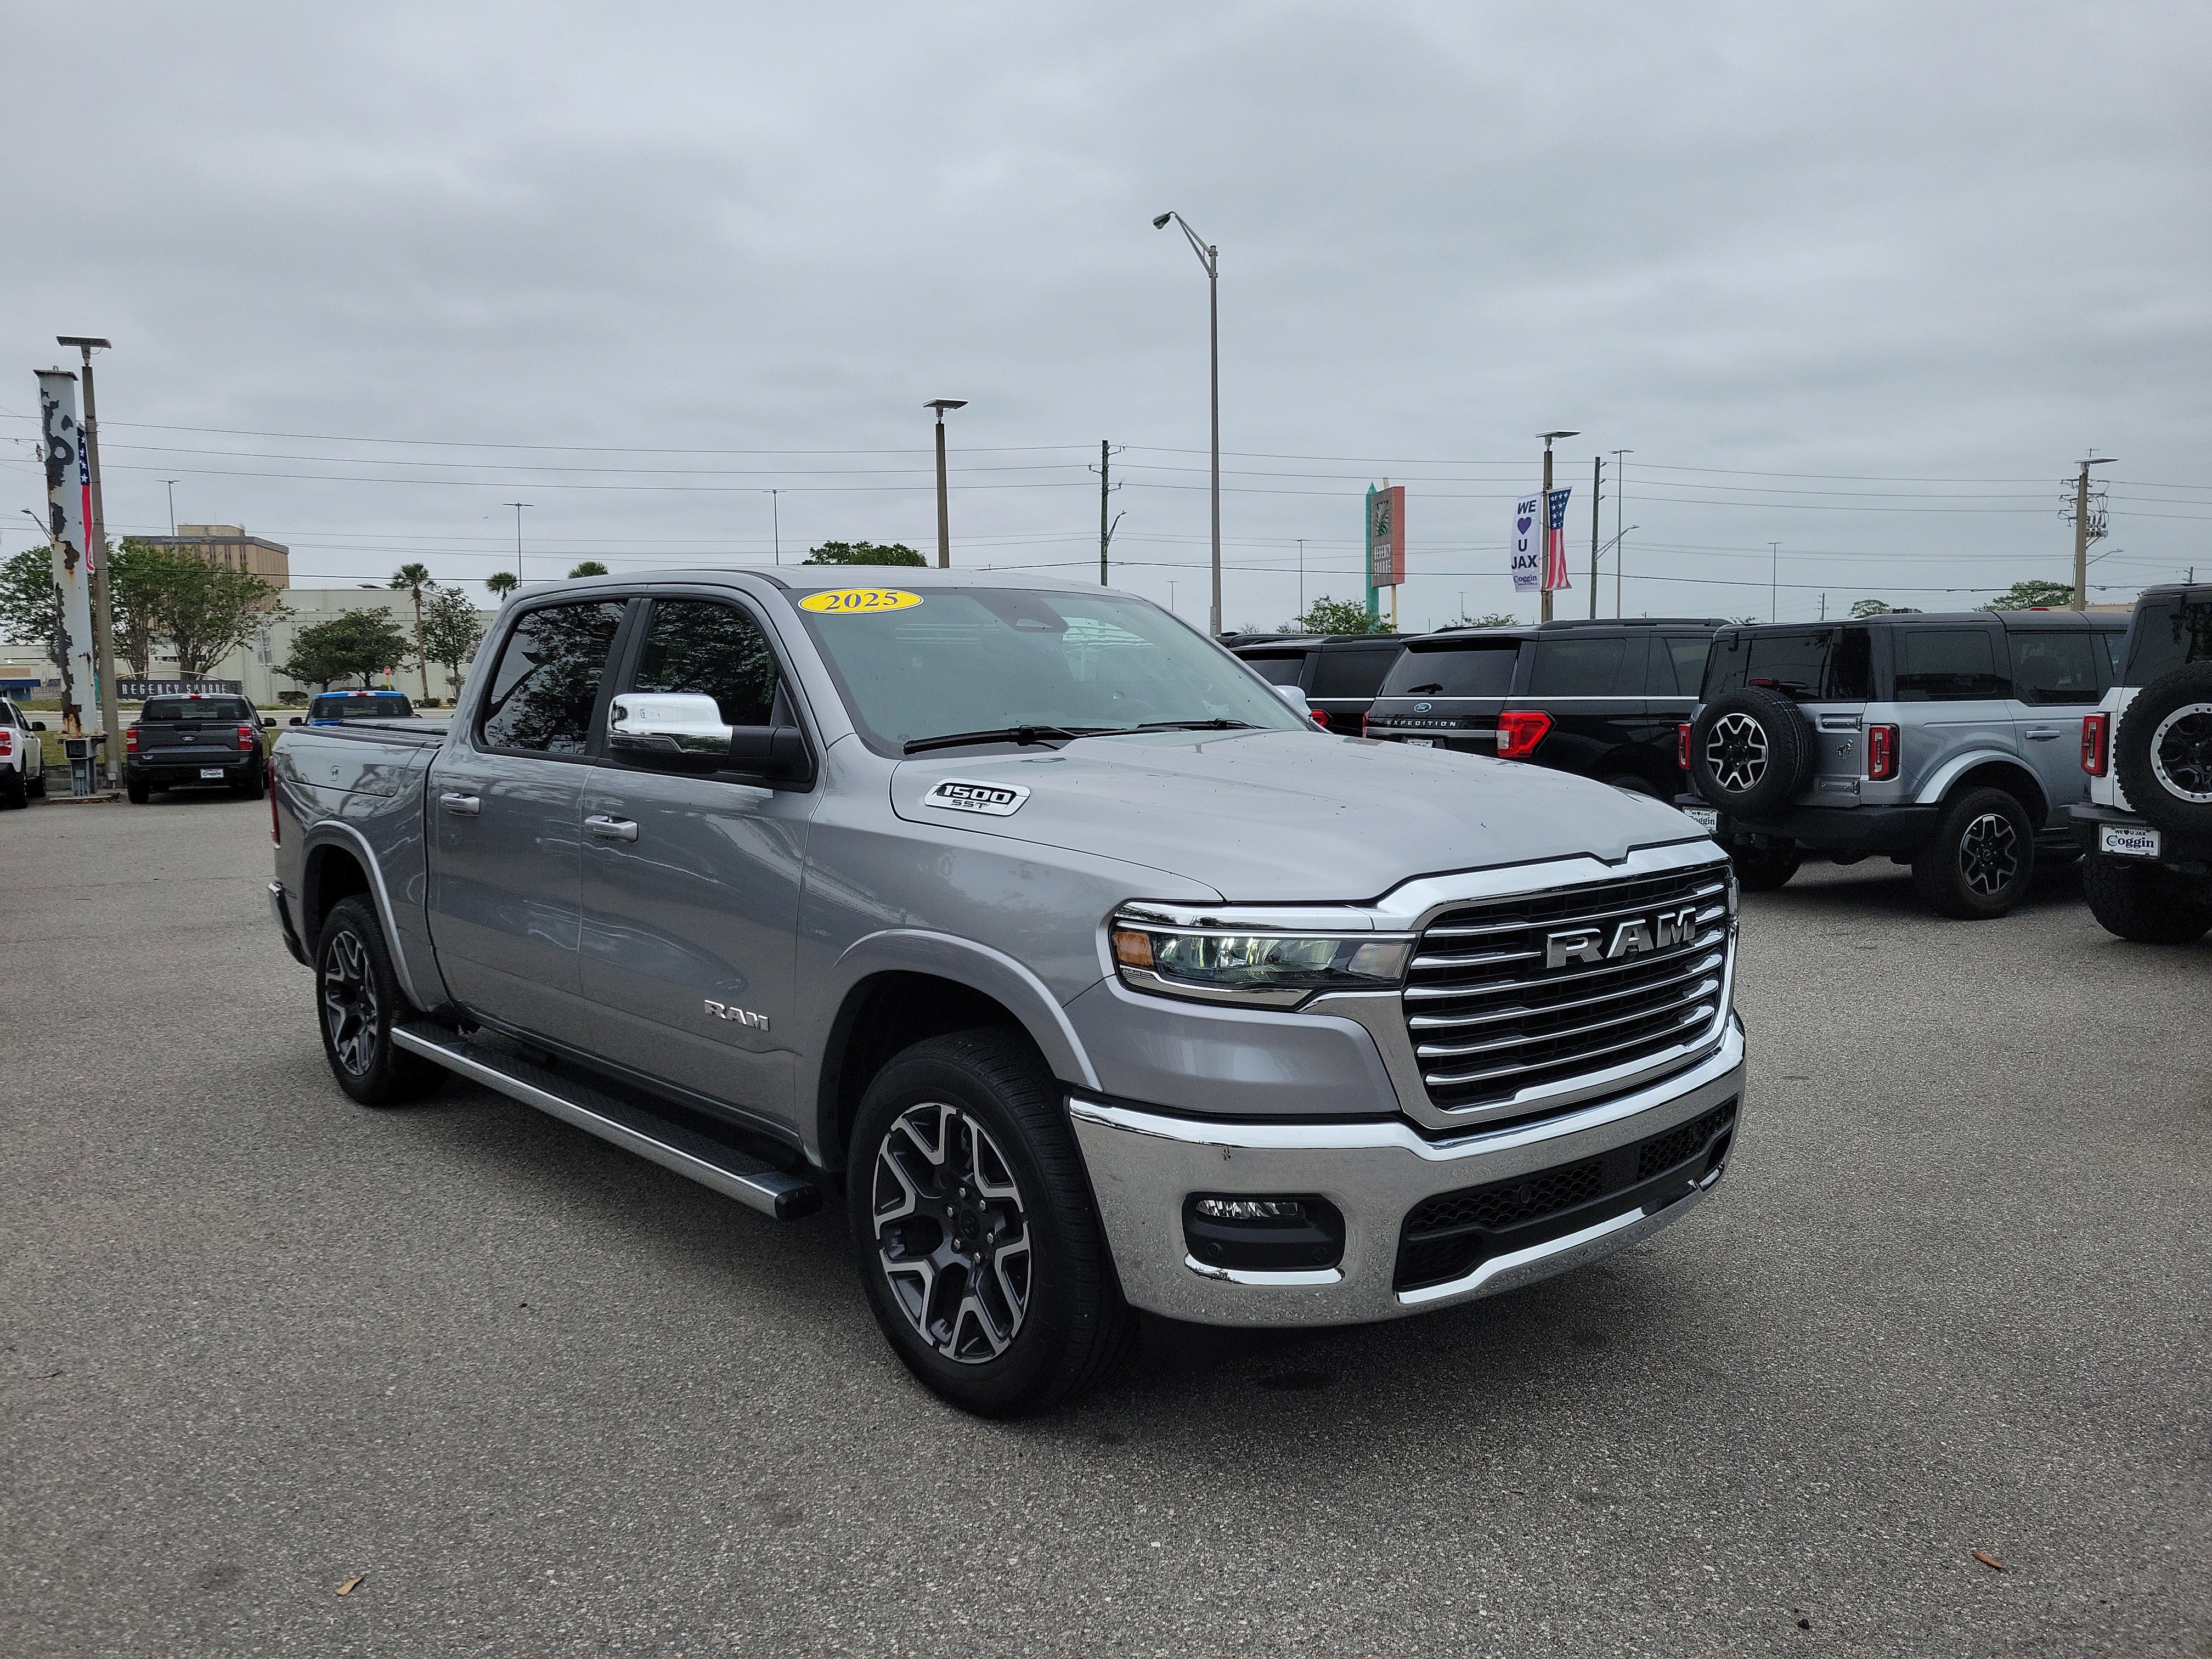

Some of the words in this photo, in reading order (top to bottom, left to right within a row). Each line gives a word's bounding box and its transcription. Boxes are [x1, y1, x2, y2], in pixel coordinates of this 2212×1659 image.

[1517, 500, 1537, 515] WE
[1374, 543, 1391, 560] REGENCY
[1518, 539, 1528, 552] U
[1511, 555, 1538, 569] JAX
[1513, 574, 1537, 584] Coggin
[824, 592, 898, 611] 2025
[122, 684, 179, 695] REGENCY
[187, 684, 227, 694] SQUARE
[944, 785, 1013, 803] 1500
[950, 799, 990, 809] SST
[1689, 816, 1716, 826] oggin
[2106, 835, 2154, 849] Coggin
[1546, 907, 1697, 969] RAM
[704, 999, 770, 1032] RAM
